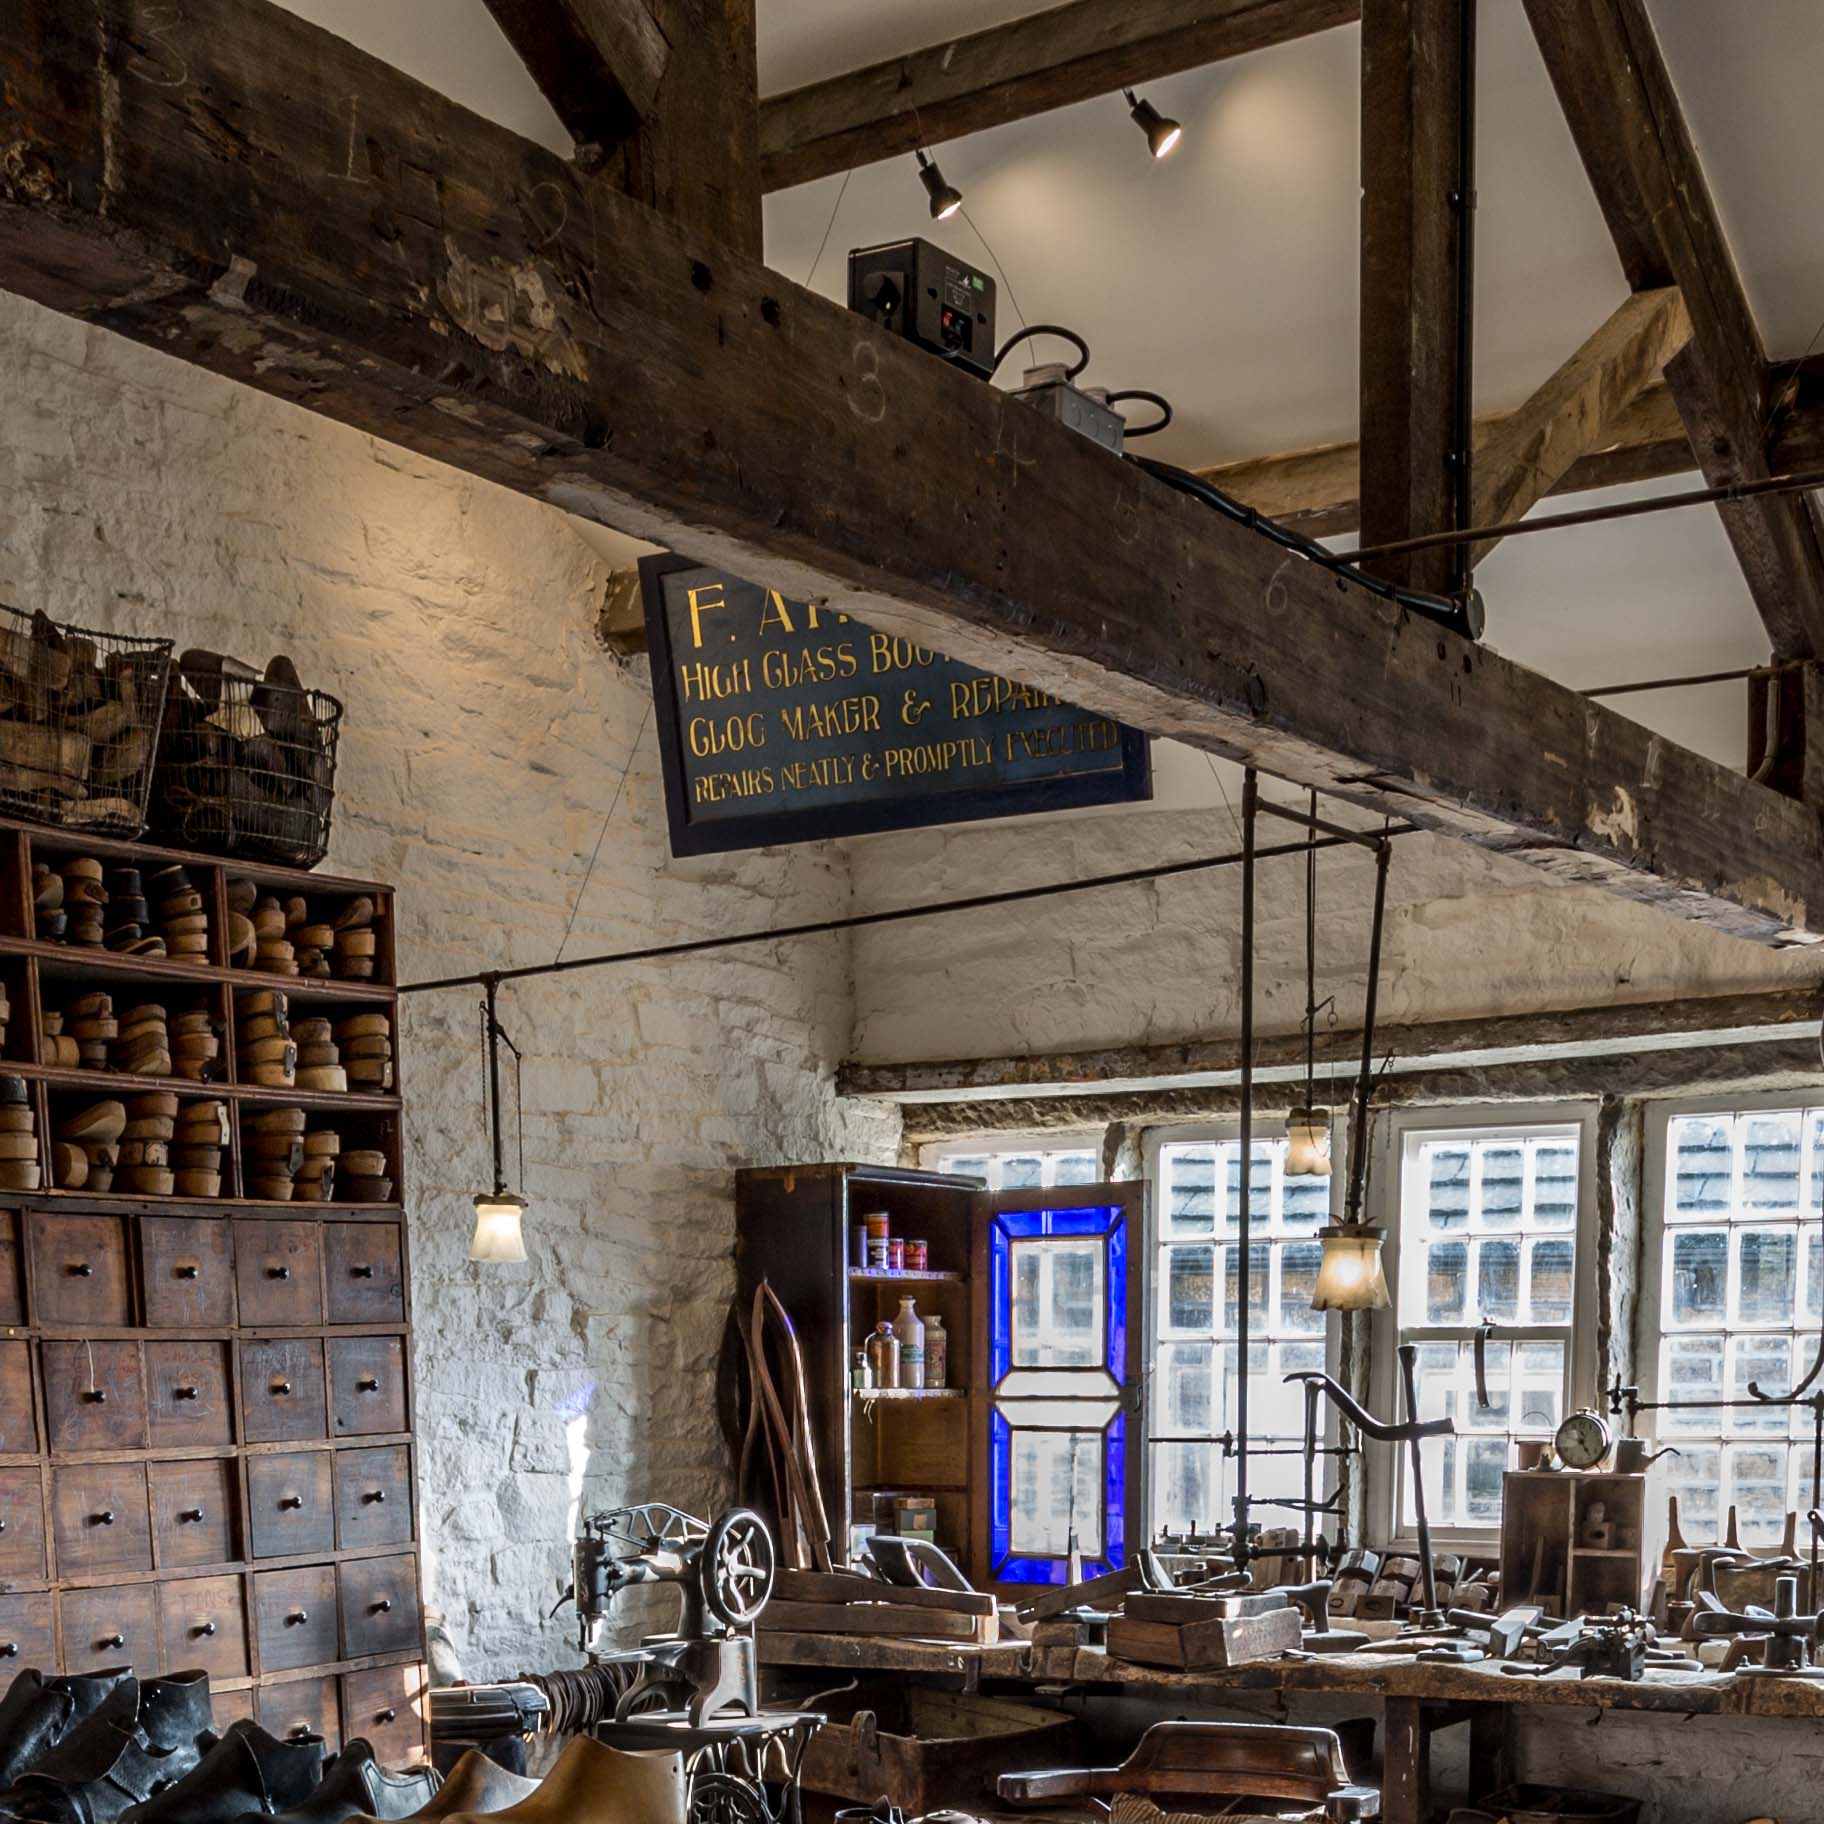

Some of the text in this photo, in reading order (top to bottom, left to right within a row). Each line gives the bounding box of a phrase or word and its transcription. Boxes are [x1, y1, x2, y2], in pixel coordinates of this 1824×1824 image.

[687, 584, 736, 649] F.
[681, 658, 752, 704] HIGH
[762, 642, 857, 689] CLASS
[689, 713, 766, 758] CLOG
[781, 695, 881, 741] MAKER
[900, 688, 931, 726] &
[694, 766, 775, 803] REPAIRS
[780, 755, 855, 791] NEATLY
[861, 752, 880, 782] &
[884, 735, 995, 777] PROMPTLY
